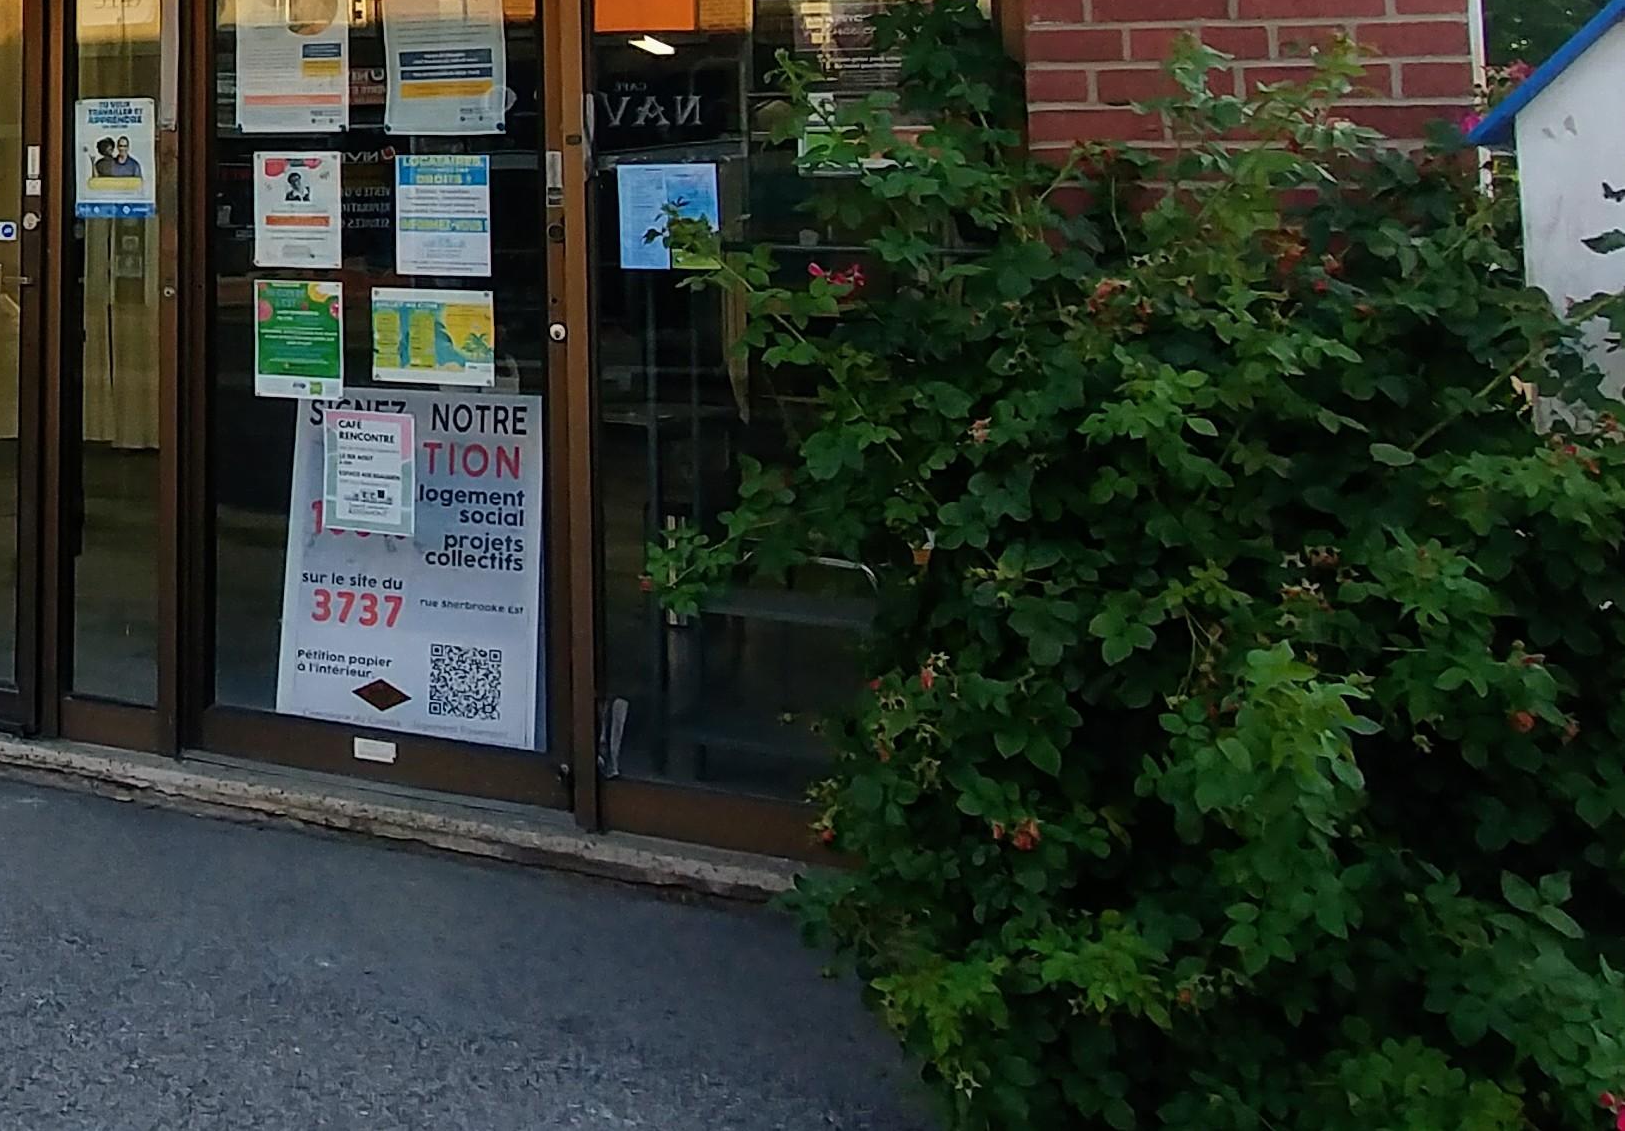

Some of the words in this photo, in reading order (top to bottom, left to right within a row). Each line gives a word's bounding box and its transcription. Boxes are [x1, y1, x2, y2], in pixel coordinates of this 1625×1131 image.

[431, 403, 528, 435] NOTRE
[338, 431, 395, 443] RENCONTRE
[423, 442, 521, 480] TION
[419, 484, 525, 507] logement
[459, 507, 525, 527] social
[443, 533, 524, 553] projets
[425, 550, 524, 571] collectifs
[302, 572, 327, 584] sur
[331, 572, 344, 586] le
[350, 573, 377, 589] site
[382, 577, 403, 590] du
[311, 588, 403, 628] 3737
[420, 599, 439, 608] rue
[441, 599, 505, 613] Sherbrooke
[508, 606, 524, 615] Est
[297, 649, 345, 663] Pétition
[349, 655, 393, 668] papier
